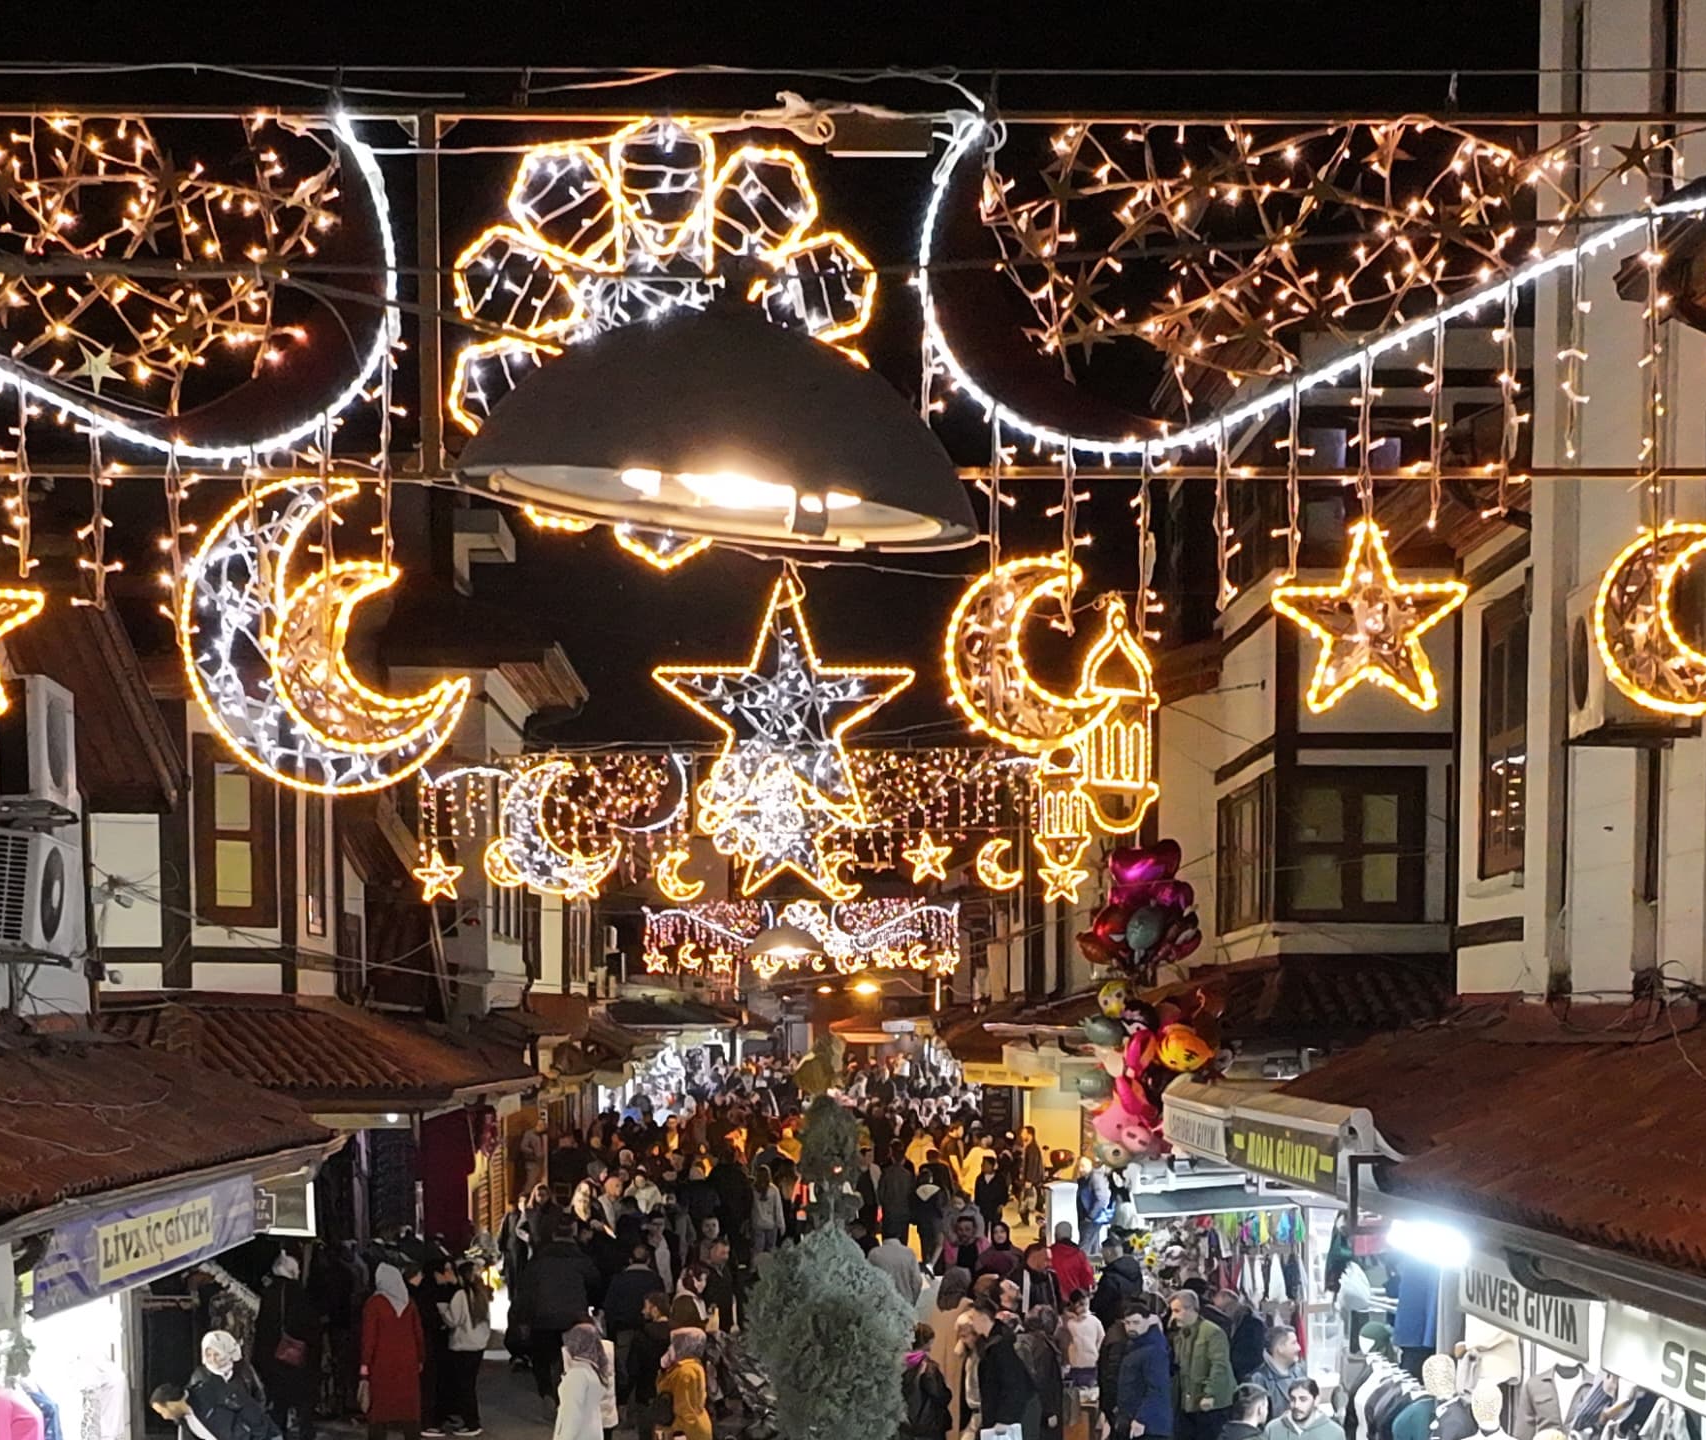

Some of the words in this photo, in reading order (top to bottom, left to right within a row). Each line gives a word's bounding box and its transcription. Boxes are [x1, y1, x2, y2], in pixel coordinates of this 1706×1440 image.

[102, 1225, 148, 1269] LİVA
[146, 1216, 164, 1262] İÇ
[164, 1203, 210, 1246] GİYİM
